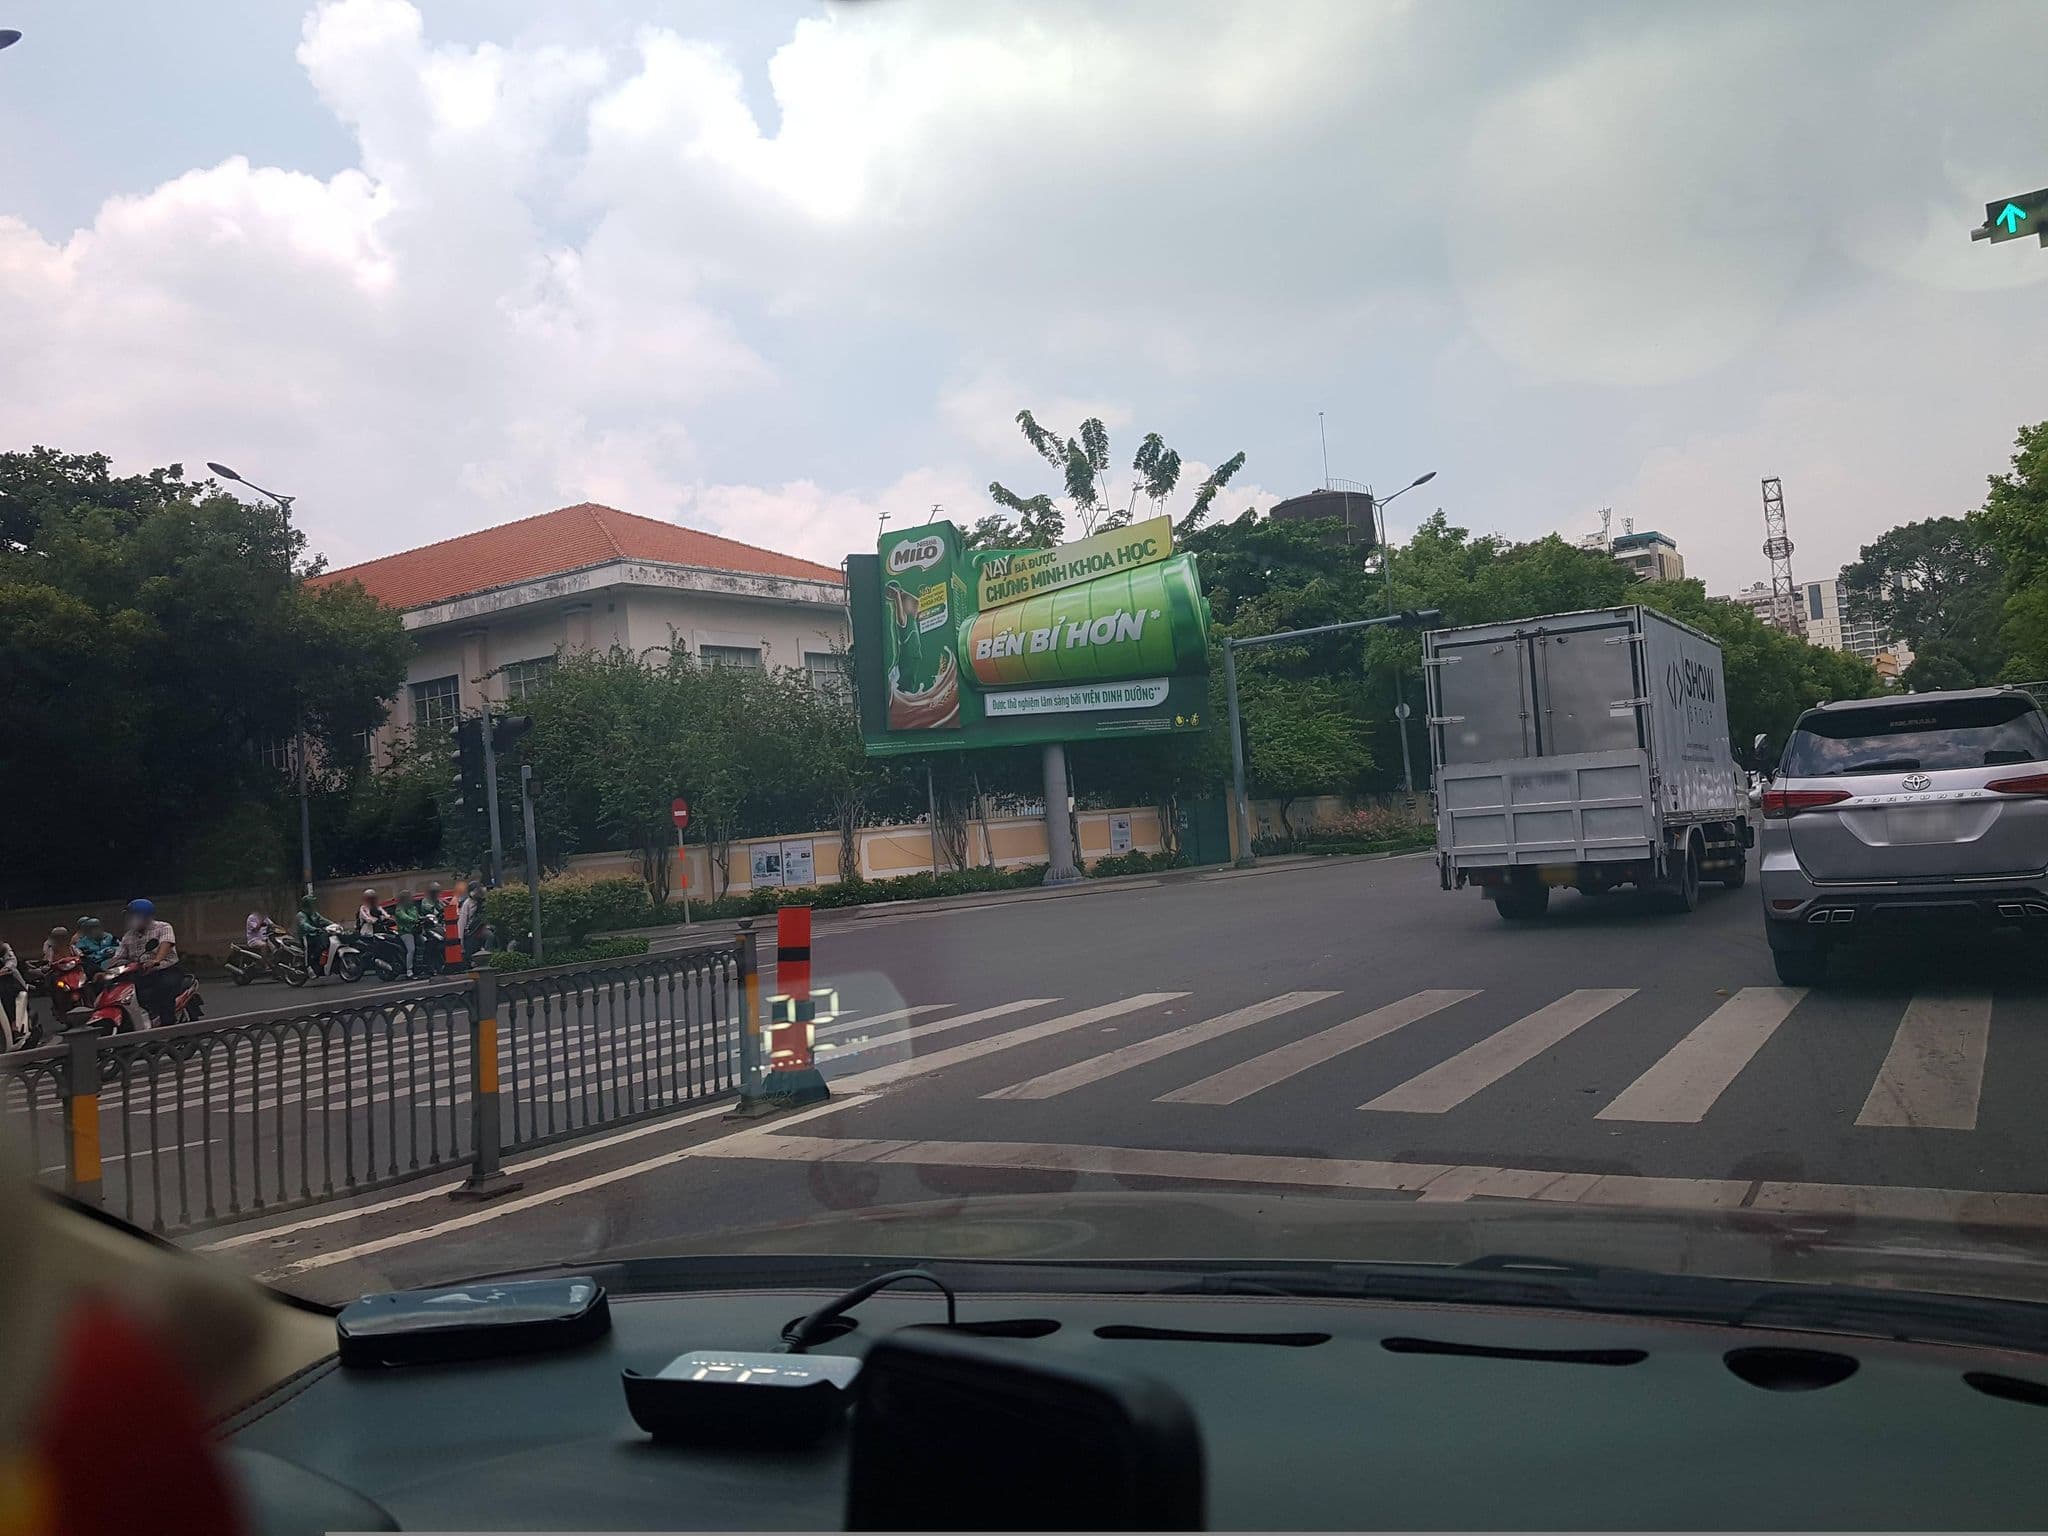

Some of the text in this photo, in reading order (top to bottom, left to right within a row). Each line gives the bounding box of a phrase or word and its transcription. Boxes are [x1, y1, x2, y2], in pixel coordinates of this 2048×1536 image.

[894, 546, 938, 566] MILO
[983, 553, 1015, 582] NAY
[1028, 552, 1057, 570] ĐƯỢC
[986, 575, 1030, 603] CHỨNG
[1031, 567, 1067, 590] MINH
[1068, 551, 1116, 579] KHOA
[1117, 538, 1158, 565] HỌC
[976, 627, 1026, 661] BỀN
[1684, 658, 1715, 704] SHOW
[1082, 689, 1101, 707] VIỆN
[1102, 688, 1122, 704] DINH
[1855, 791, 1983, 804] FORTUNER
